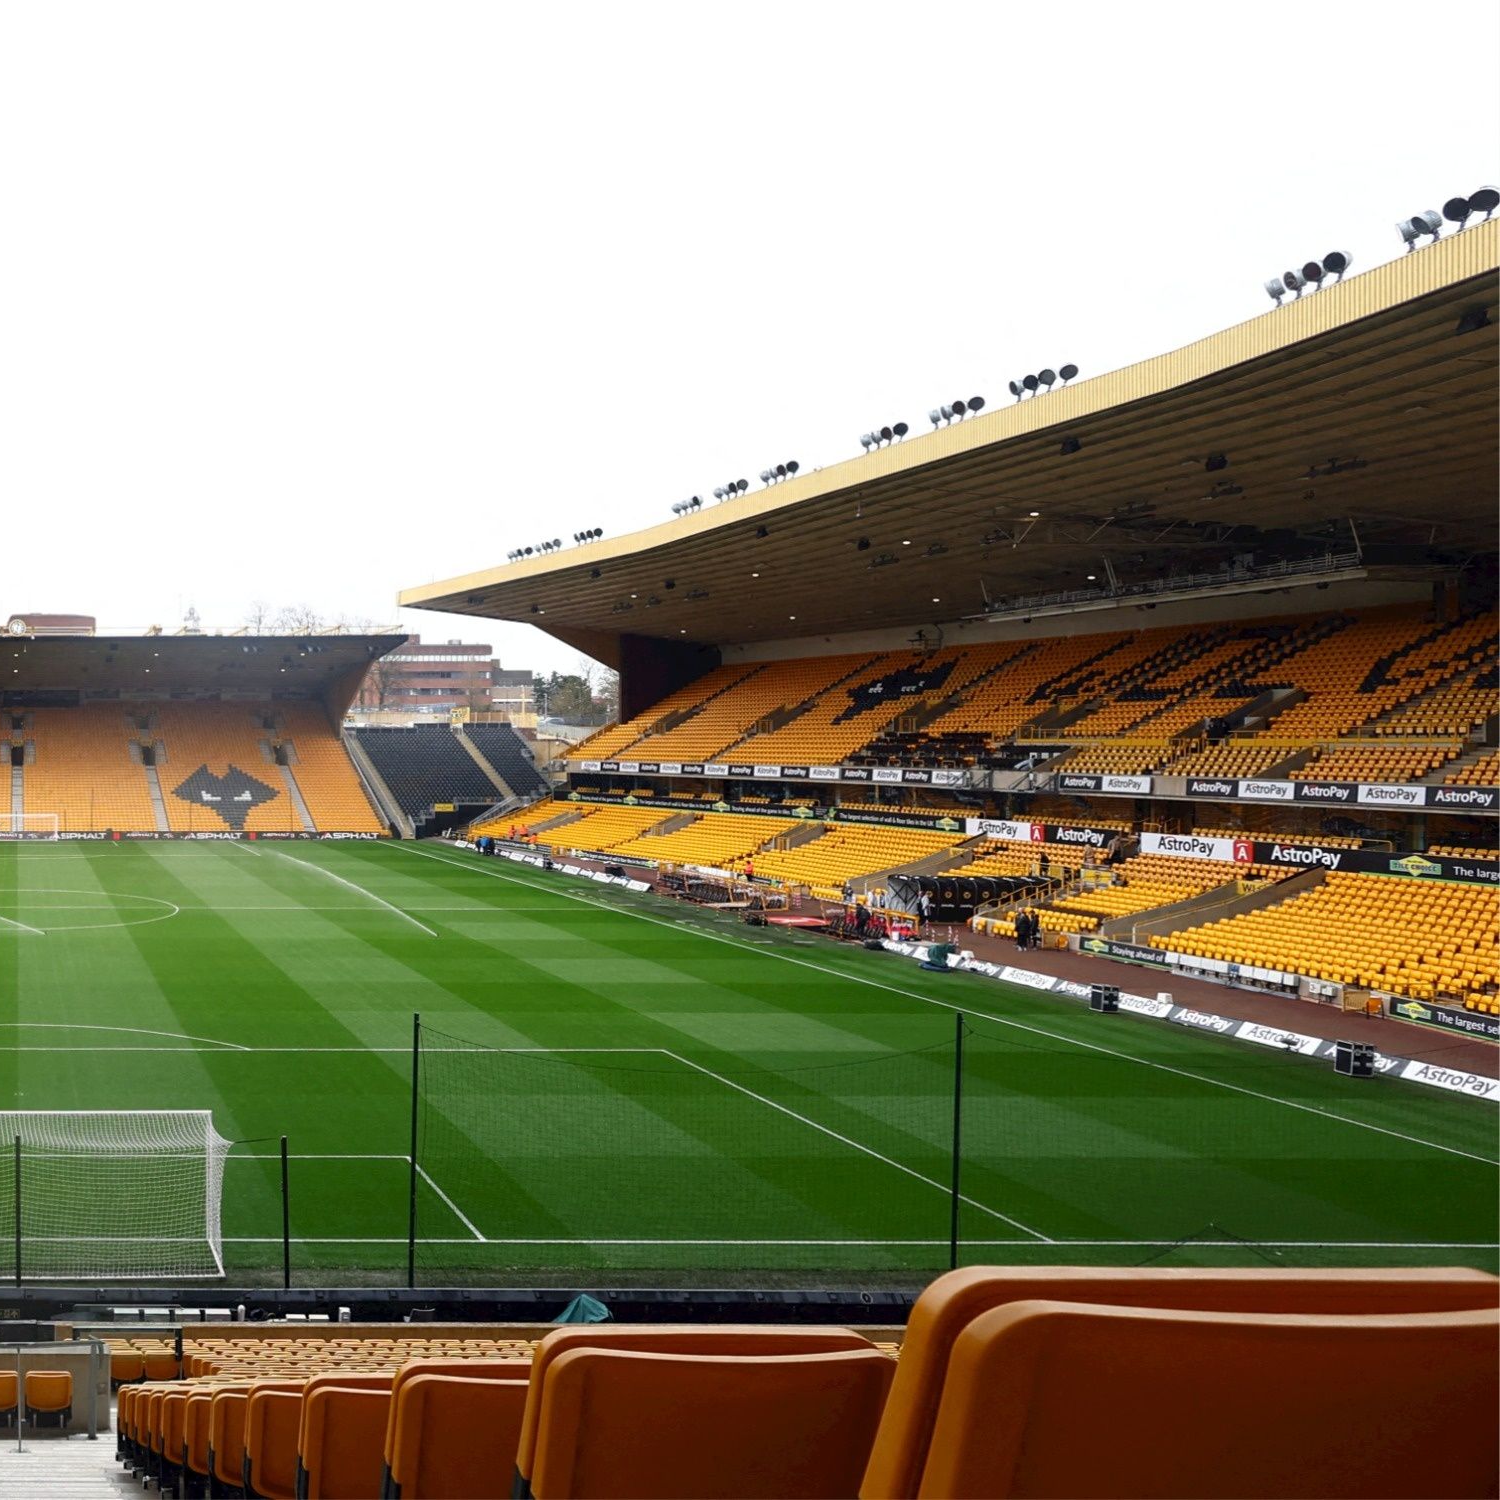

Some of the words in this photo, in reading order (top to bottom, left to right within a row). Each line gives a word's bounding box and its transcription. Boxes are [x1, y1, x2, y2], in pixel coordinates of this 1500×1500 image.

[844, 769, 867, 780] AstroPay
[876, 770, 899, 781] AstroPay
[904, 771, 928, 782] AstroPay
[1063, 777, 1096, 788] AstroPay
[1108, 778, 1142, 790] AstroPay
[1191, 781, 1232, 795] AstroPay
[1245, 783, 1287, 797] AstroPay
[1301, 785, 1350, 799] AstroPay
[1366, 787, 1418, 802] AstroPay
[1435, 789, 1494, 806] AstroPay
[53, 832, 107, 840] ASPHALT
[977, 821, 1018, 837] AstroPay
[1056, 827, 1105, 846] AstroPay
[1158, 836, 1215, 857] AstroPay
[1271, 845, 1342, 869] AstroPay
[1453, 866, 1473, 877] The
[1112, 945, 1134, 958] Staying
[1135, 948, 1154, 960] ahead
[1155, 953, 1164, 962] of
[961, 959, 999, 976] AstroPay
[1008, 967, 1048, 989] AstroPay
[1119, 992, 1164, 1015] stroPay
[1175, 1008, 1233, 1032] AstroPay
[1436, 1012, 1453, 1024] The
[1455, 1016, 1485, 1033] largest
[1249, 1022, 1311, 1050] AstroPay
[1325, 1044, 1398, 1072] APay
[1415, 1065, 1497, 1096] AstroPay
